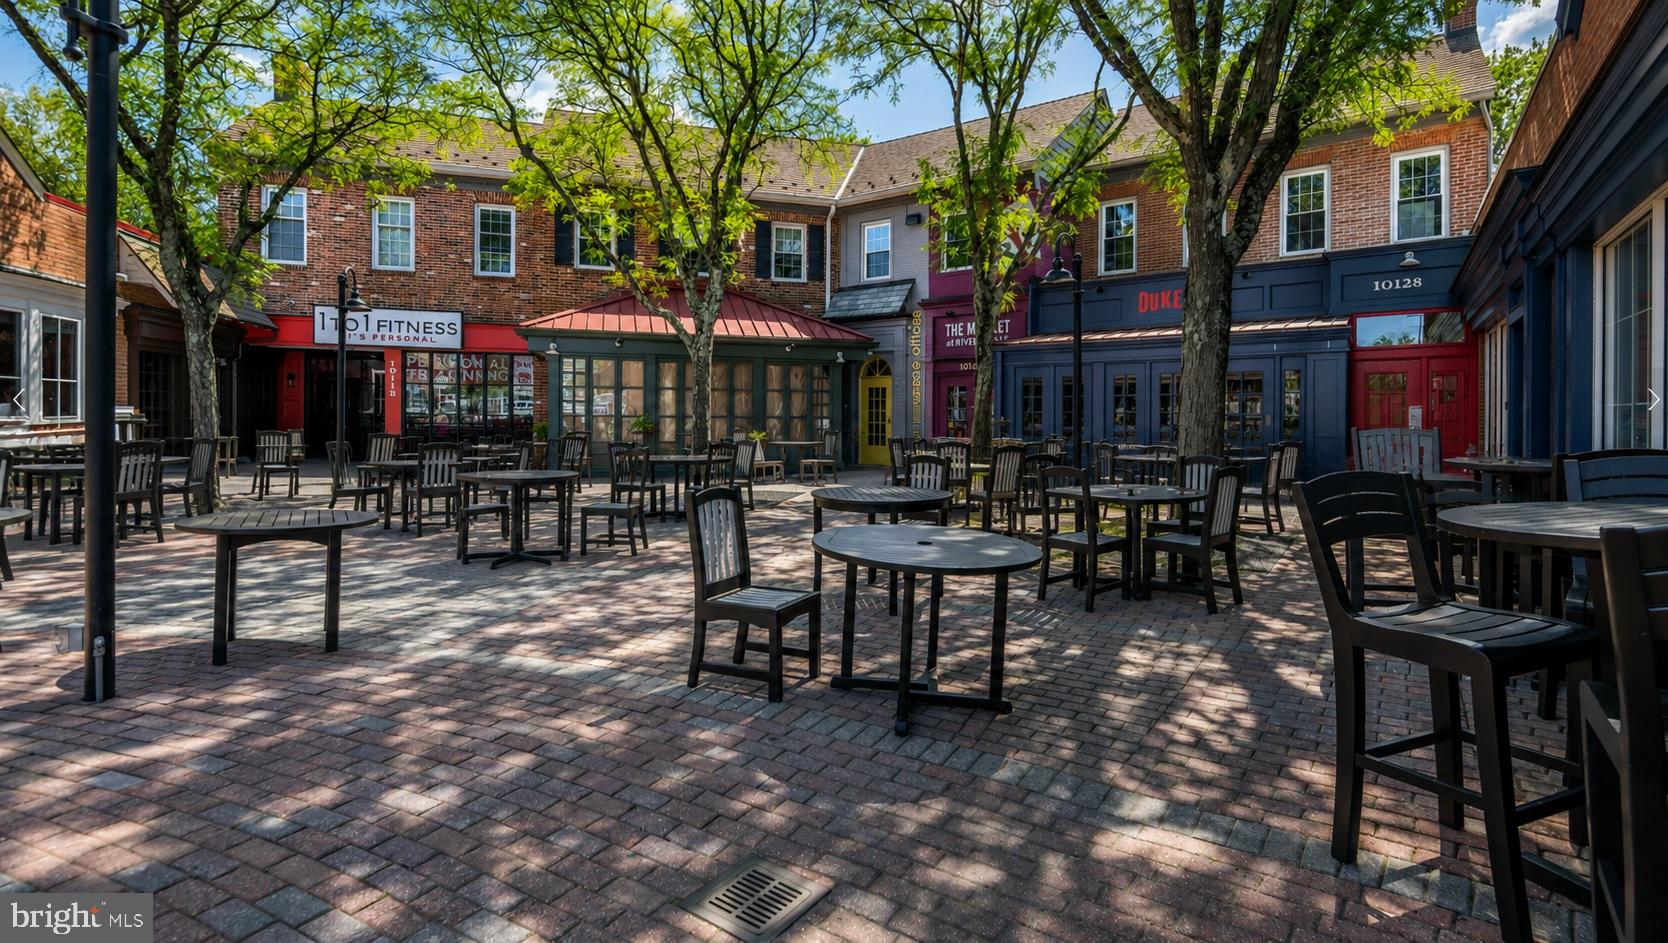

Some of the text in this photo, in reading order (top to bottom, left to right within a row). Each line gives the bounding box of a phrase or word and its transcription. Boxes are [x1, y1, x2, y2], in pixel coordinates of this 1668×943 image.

[1373, 277, 1423, 292] 10128
[377, 319, 458, 336] FITNESS
[945, 319, 1011, 337] THE MET
[372, 334, 437, 343] PERSONAL
[955, 337, 976, 347] RIVE
